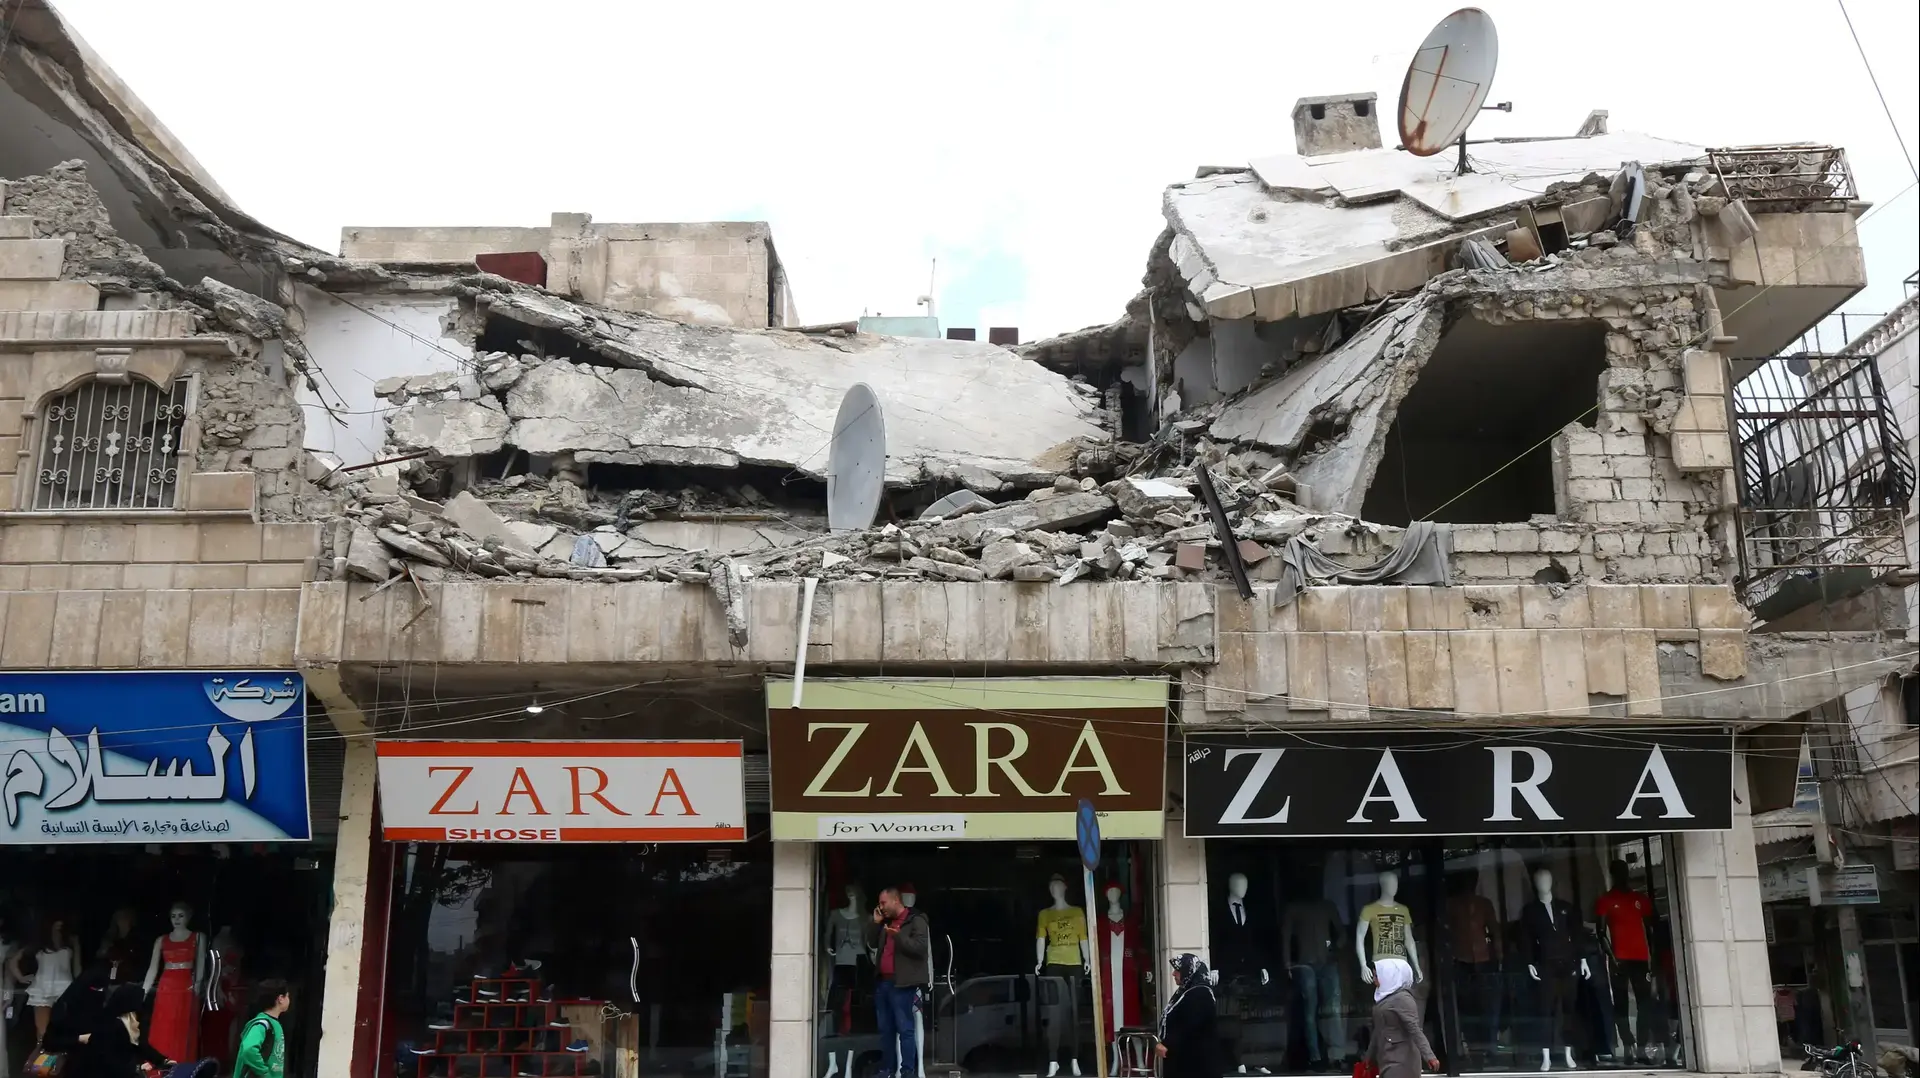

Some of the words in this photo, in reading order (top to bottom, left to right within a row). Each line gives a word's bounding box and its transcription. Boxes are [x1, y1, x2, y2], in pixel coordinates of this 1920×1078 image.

[212, 677, 296, 703] شركة
[4, 725, 256, 827] السلام
[802, 720, 1131, 798] ZARA
[428, 766, 701, 816] ZARA
[1218, 746, 1695, 824] ZARA
[448, 829, 557, 841] SHOSE
[826, 821, 864, 837] for
[868, 822, 957, 834] Women
